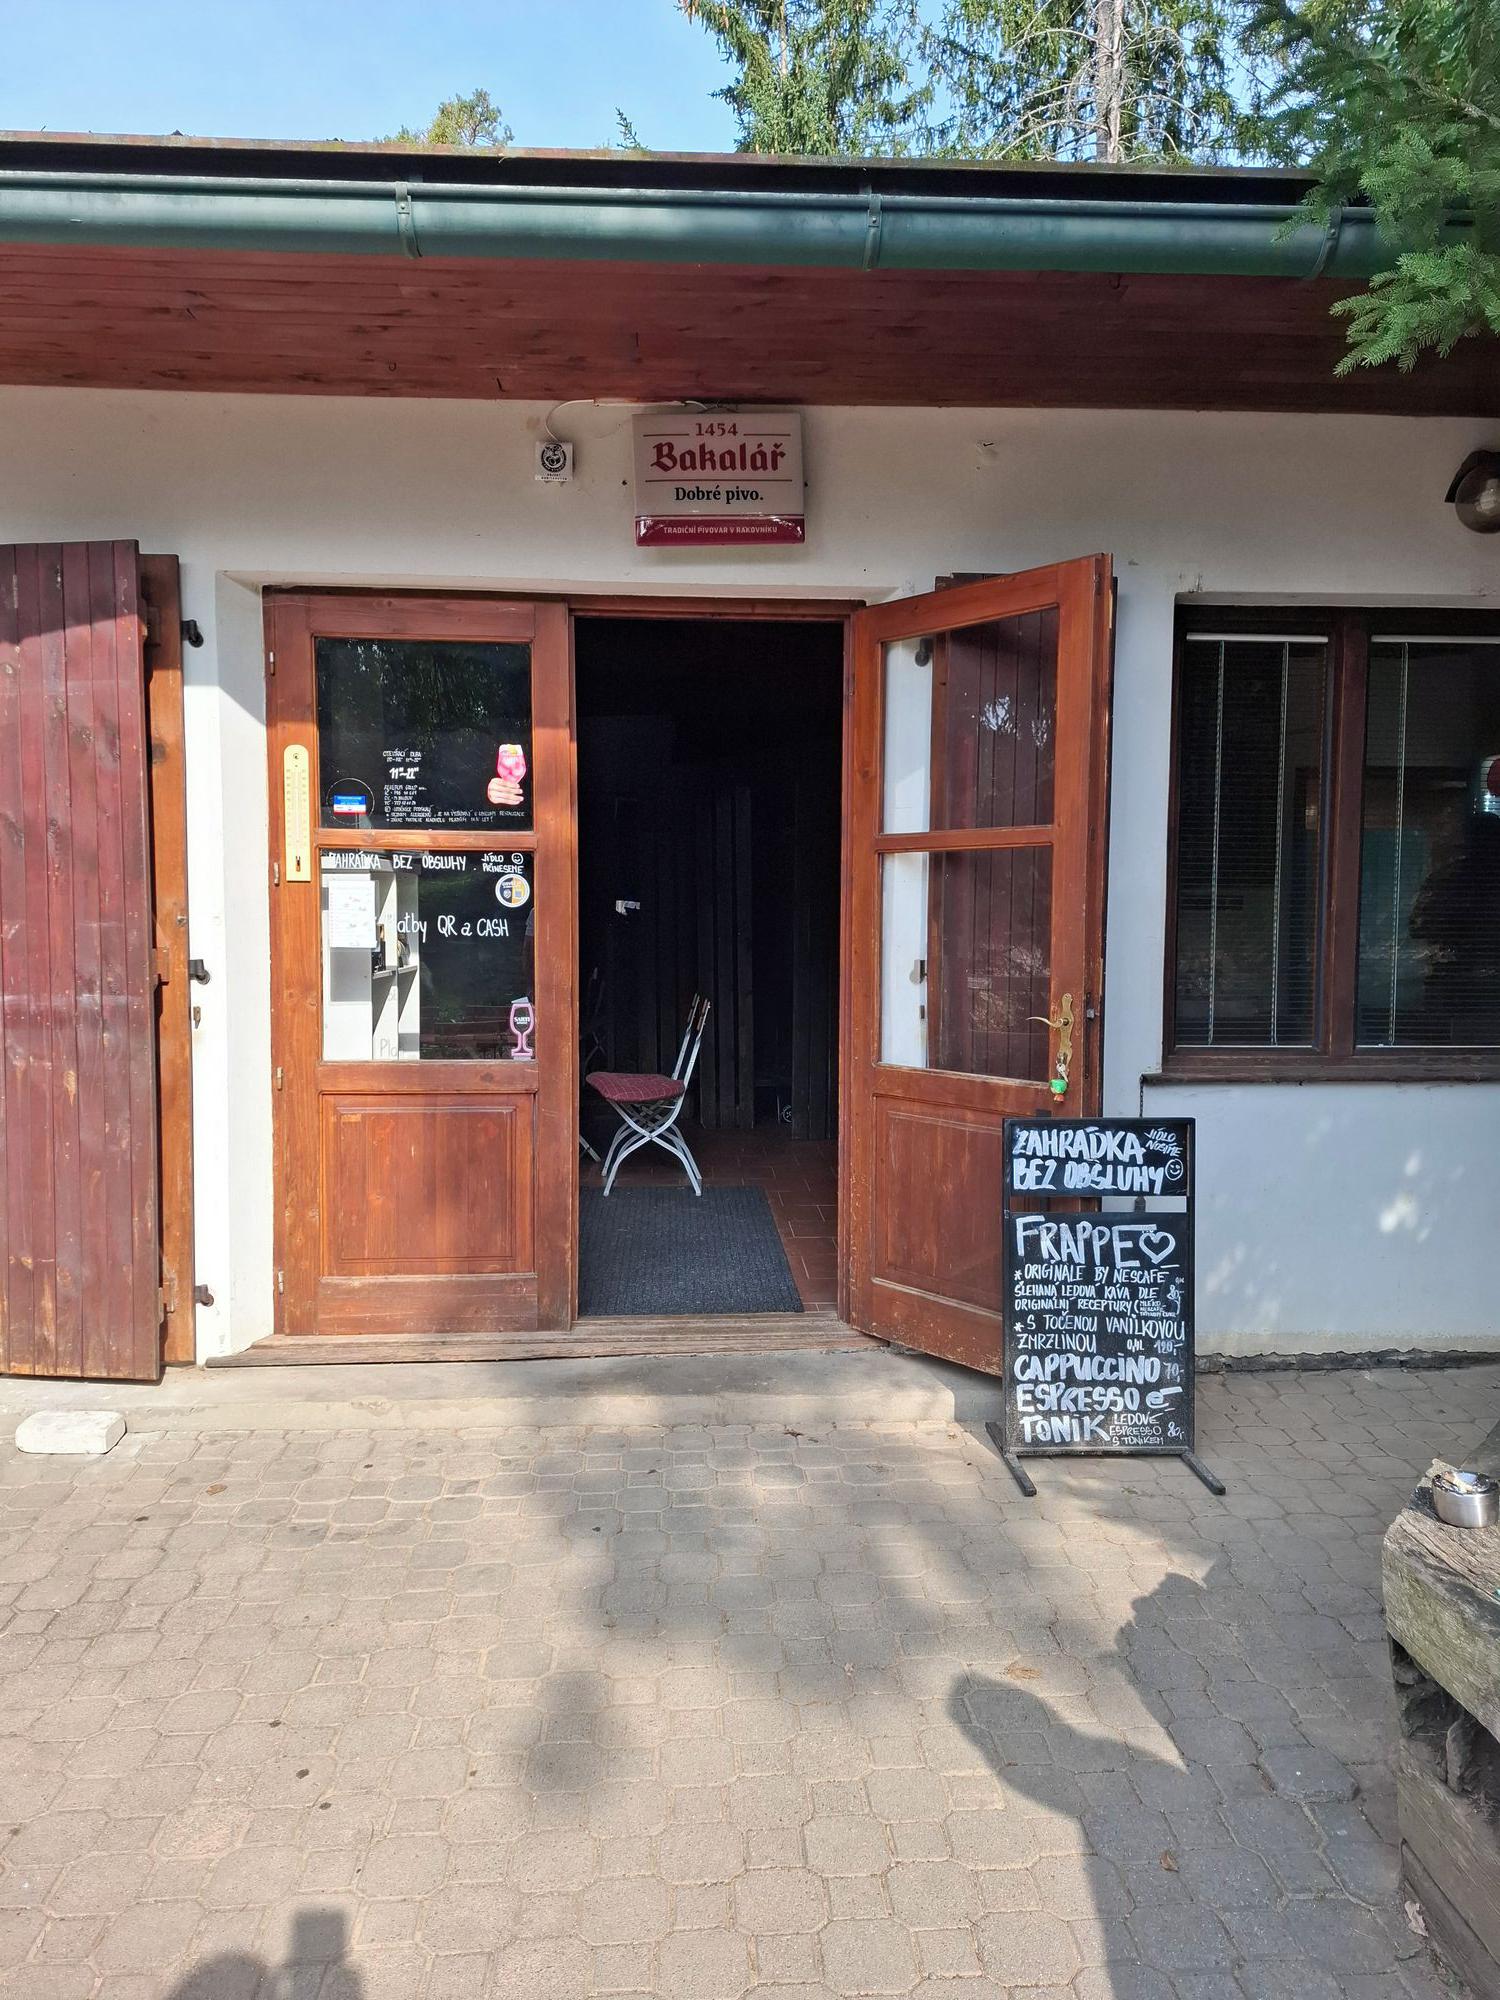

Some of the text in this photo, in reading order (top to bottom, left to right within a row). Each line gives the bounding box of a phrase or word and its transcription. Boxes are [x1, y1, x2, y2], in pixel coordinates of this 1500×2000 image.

[695, 422, 738, 437] 1454
[650, 441, 786, 472] Bakalář
[674, 484, 764, 505] Dobré pivo.
[663, 525, 778, 534] TRADIČNÍ PIVOVAR V RAKOVNÍKU
[393, 855, 413, 870] BEZ
[422, 855, 467, 871] OBSLUHY
[481, 852, 504, 863] JÍDLO
[437, 915, 458, 937] QR
[461, 923, 473, 936] a
[476, 917, 510, 937] CASH
[1012, 1126, 1176, 1164] ZAHRÁDKA JÍDLO
[1013, 1157, 1165, 1195] BEZ OBSLUHY
[1094, 1265, 1109, 1284] BY
[1061, 1282, 1101, 1298] LEDOVÁ
[1104, 1283, 1130, 1300] KÁVA
[1138, 1286, 1160, 1300] DLE
[1026, 1310, 1185, 1341] S TOČENOU VANILKOVOU
[1016, 1331, 1097, 1354] ZMRZLINOU
[1013, 1352, 1161, 1385] CAPPUCCINO
[1016, 1382, 1140, 1413] ESPRESSO
[1019, 1414, 1111, 1443] TONIK
[1109, 1425, 1162, 1436] ESPRESSO
[1112, 1435, 1120, 1447] S
